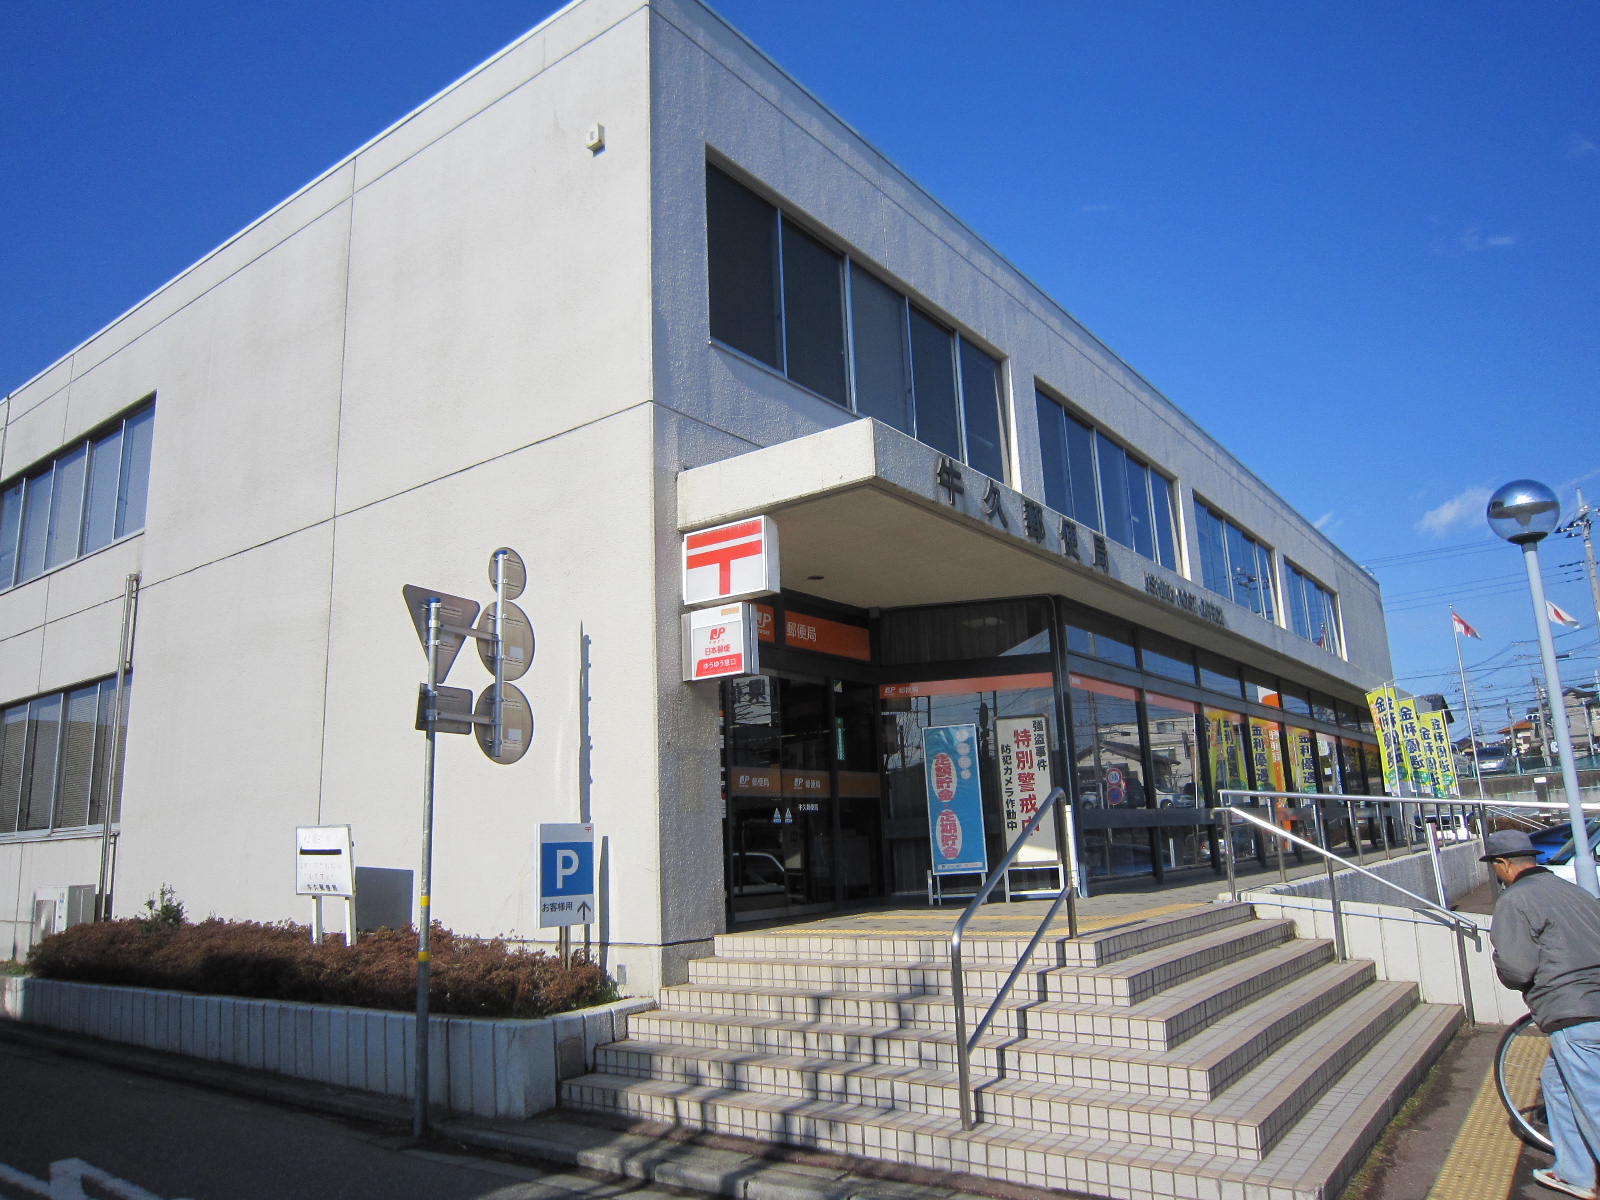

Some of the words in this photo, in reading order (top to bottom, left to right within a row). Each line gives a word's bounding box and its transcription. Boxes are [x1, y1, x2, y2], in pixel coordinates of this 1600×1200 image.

[936, 456, 1110, 576] 牛久郵便局
[787, 622, 817, 642] 郵便局
[703, 658, 737, 669] ゆうゆう窓口
[705, 644, 731, 656] 日本郵便
[1032, 719, 1048, 771] 強盗事件
[1000, 744, 1018, 831] 防犯カメラ作動中
[556, 849, 579, 889] P
[541, 901, 573, 912] お客様用
